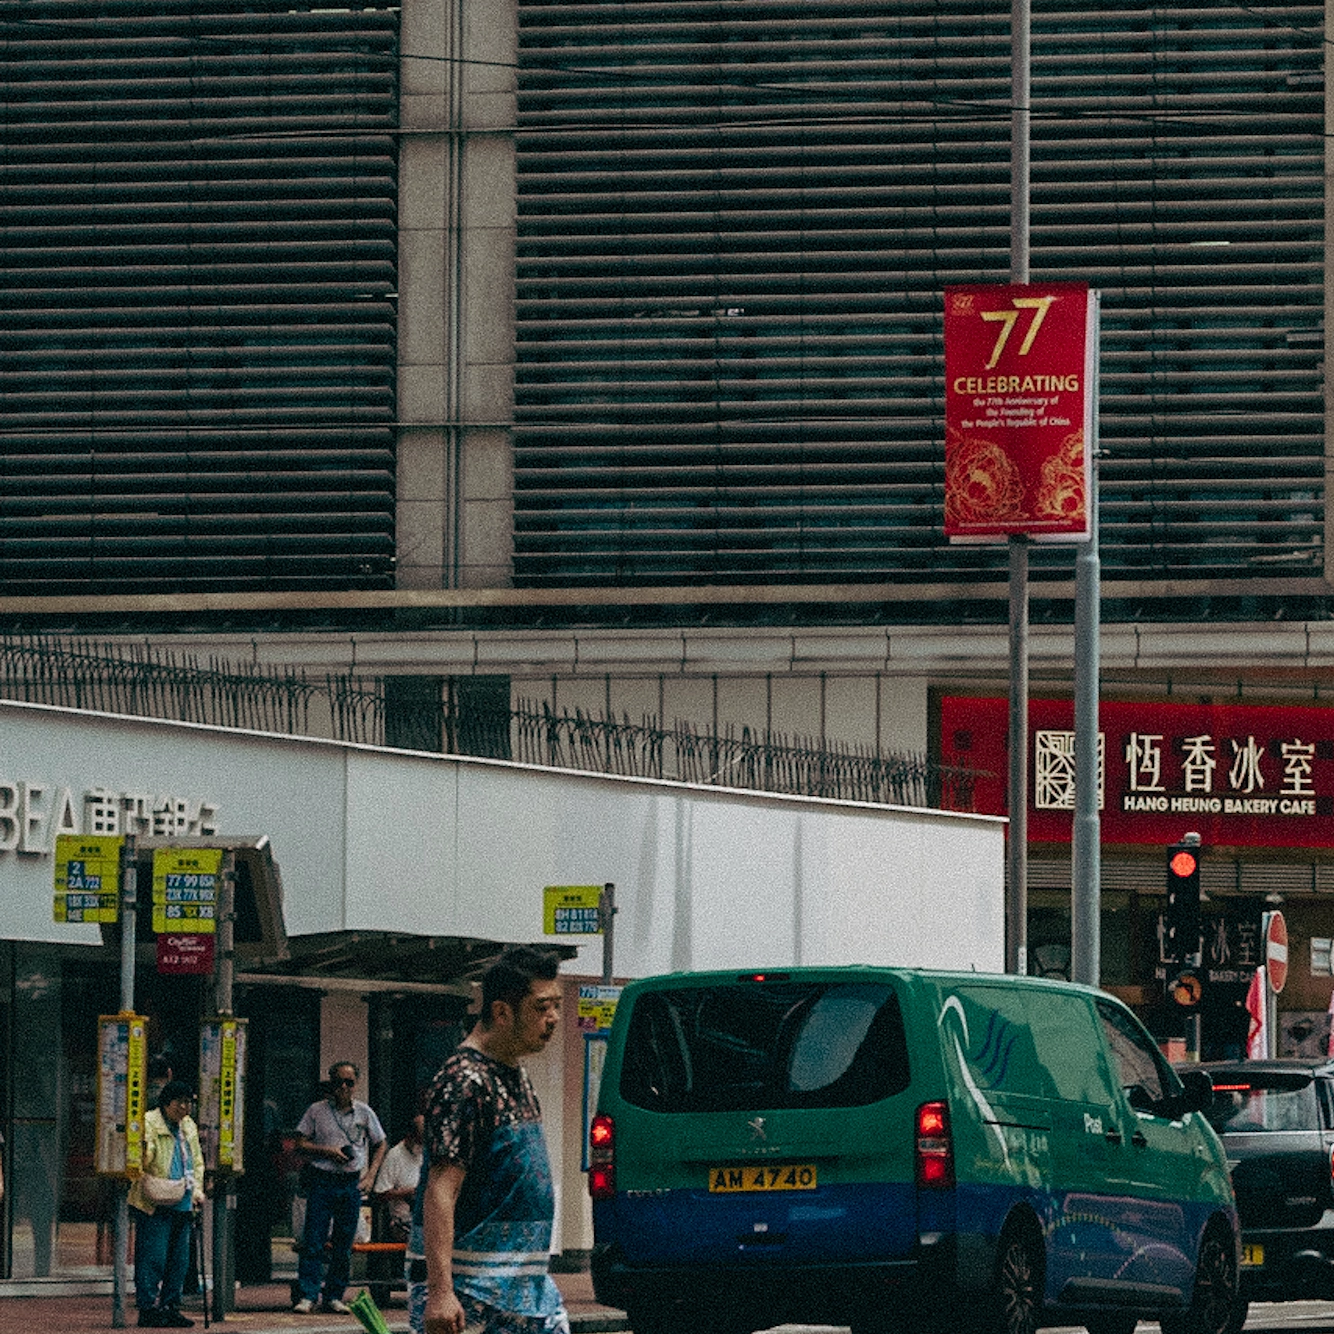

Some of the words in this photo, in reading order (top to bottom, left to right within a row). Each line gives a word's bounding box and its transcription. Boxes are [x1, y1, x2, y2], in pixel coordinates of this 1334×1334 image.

[980, 296, 1052, 370] 77
[953, 374, 1079, 395] CELEBRATING
[1124, 796, 1169, 812] HANG
[1171, 797, 1220, 813] HEUNG
[1224, 798, 1278, 814] BAKERY
[1280, 799, 1316, 815] CAFE
[72, 861, 81, 874] 2
[67, 875, 84, 888] 2A
[168, 874, 181, 887] 77
[183, 874, 198, 887] 99
[714, 1169, 743, 1189] AM
[752, 1167, 813, 1187] 4740
